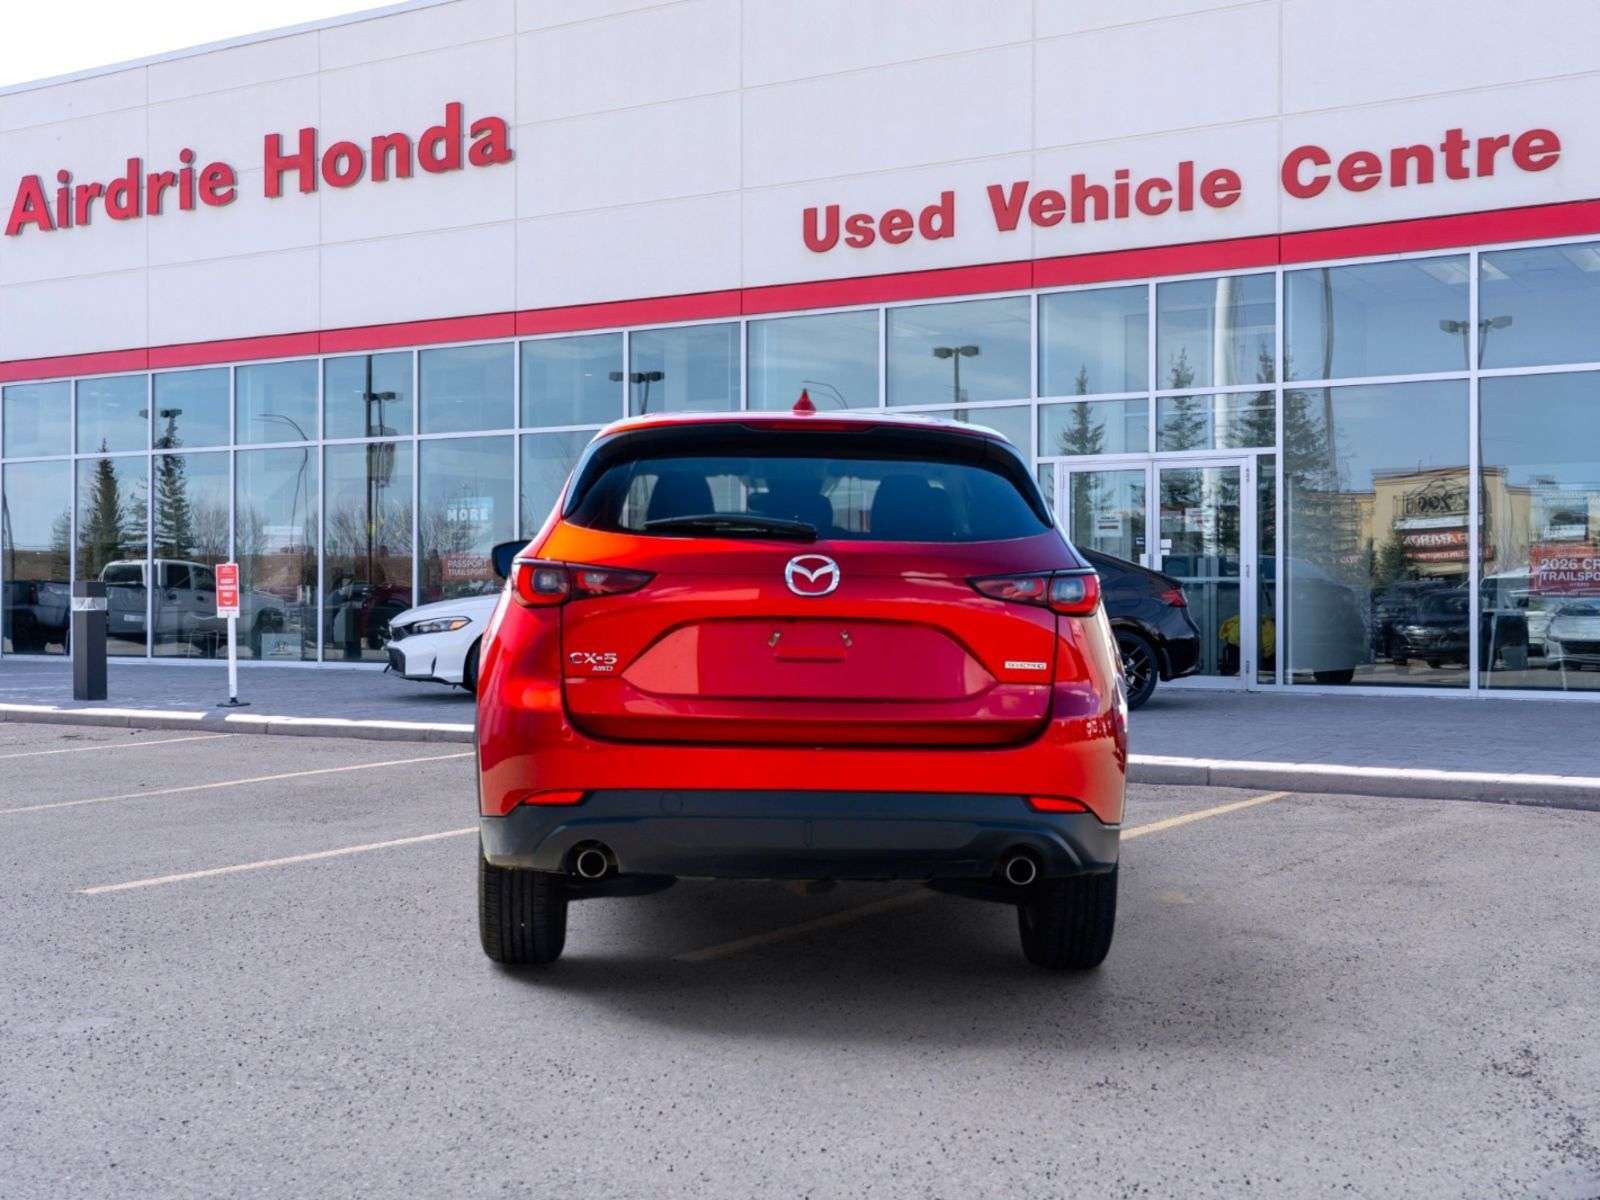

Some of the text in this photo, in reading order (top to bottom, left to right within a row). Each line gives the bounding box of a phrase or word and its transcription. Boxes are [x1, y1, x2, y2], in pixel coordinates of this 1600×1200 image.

[6, 102, 513, 235] Airdrie Honda
[803, 128, 1560, 253] Used Vehicle Centre
[1540, 558, 1579, 570] 2026
[569, 652, 618, 665] CX-5
